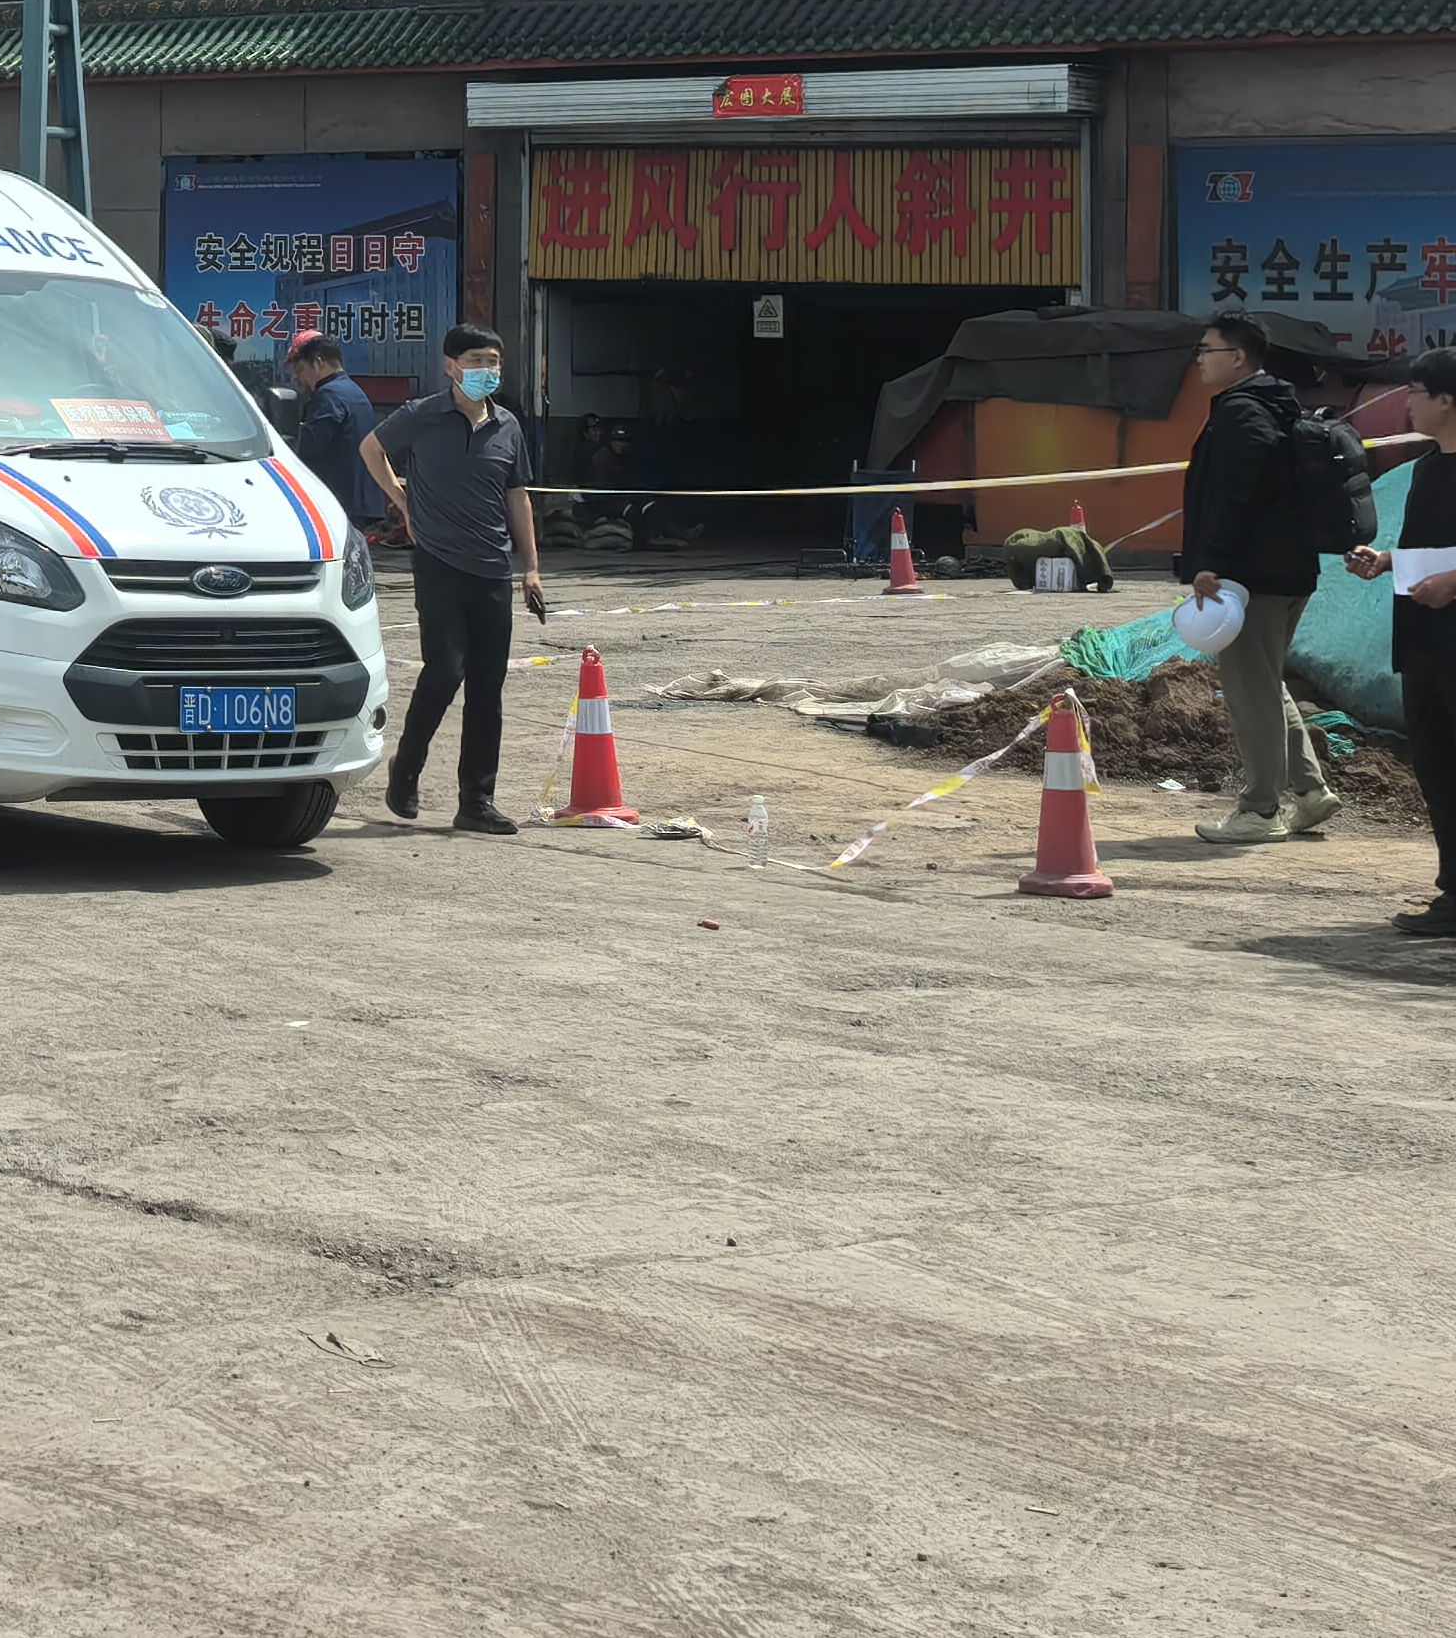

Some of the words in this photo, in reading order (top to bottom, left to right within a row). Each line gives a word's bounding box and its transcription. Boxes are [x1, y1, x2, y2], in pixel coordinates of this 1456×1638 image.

[540, 149, 1072, 256] 进风行人斜井
[195, 232, 426, 273] 安全规程日日守
